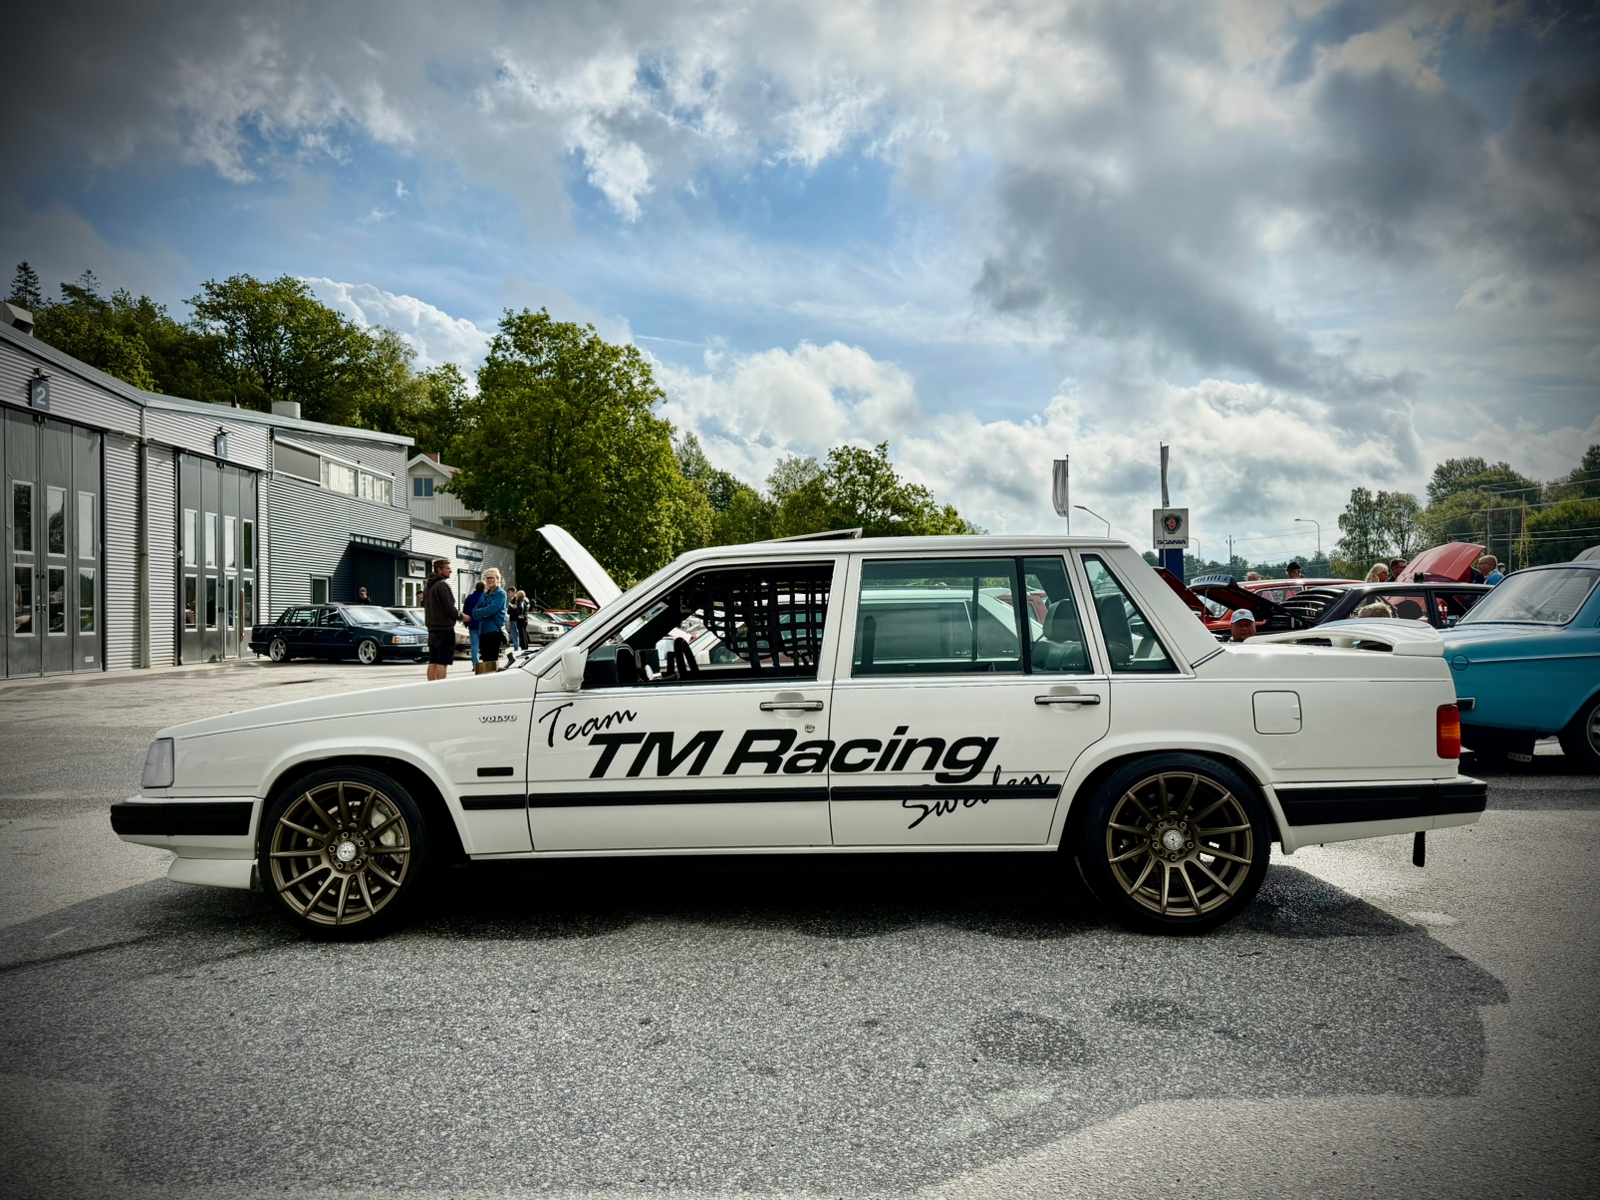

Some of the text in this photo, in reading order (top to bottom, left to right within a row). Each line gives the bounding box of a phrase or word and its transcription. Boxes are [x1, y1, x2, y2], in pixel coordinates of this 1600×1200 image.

[36, 387, 46, 406] 2
[220, 441, 225, 455] 1
[478, 714, 518, 724] VOLVO
[538, 702, 638, 748] Team
[588, 725, 999, 784] TM Racing
